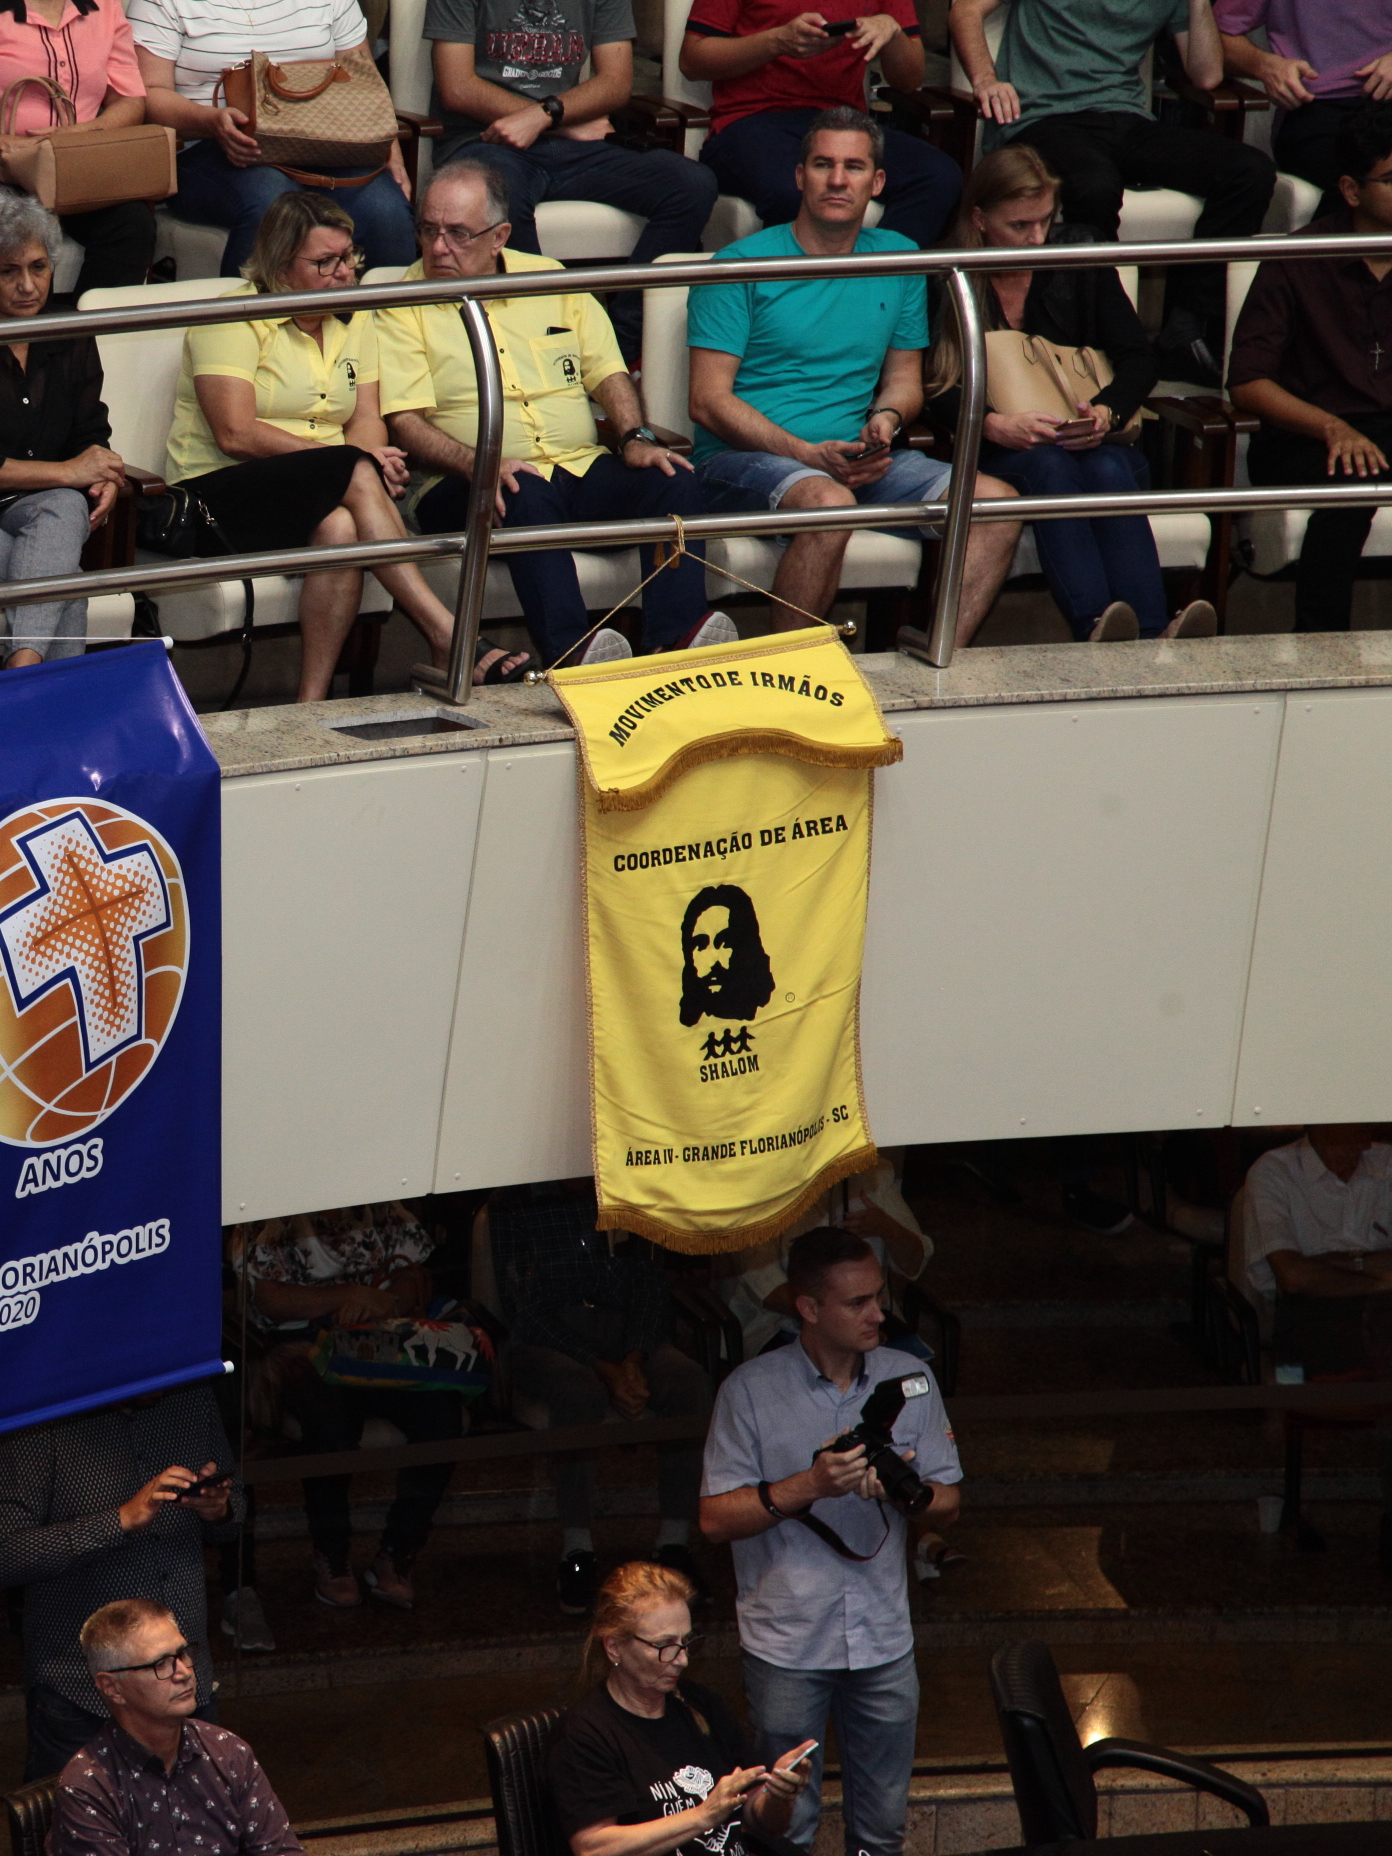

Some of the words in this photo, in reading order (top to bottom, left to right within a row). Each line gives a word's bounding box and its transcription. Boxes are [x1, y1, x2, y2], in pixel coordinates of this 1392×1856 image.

[487, 32, 585, 62] URBAN
[750, 671, 845, 707] IRMÃOS
[613, 831, 752, 872] COORDENAÇÃO
[760, 826, 786, 847] DE
[791, 814, 848, 840] ÁREA
[699, 1054, 759, 1083] SHALOM
[625, 1147, 661, 1166] ÁREA
[682, 1142, 737, 1162] GRANDE
[740, 1116, 825, 1156] FLORIANÓPOLIS
[832, 1104, 849, 1123] SC
[19, 1142, 101, 1194] ANOS
